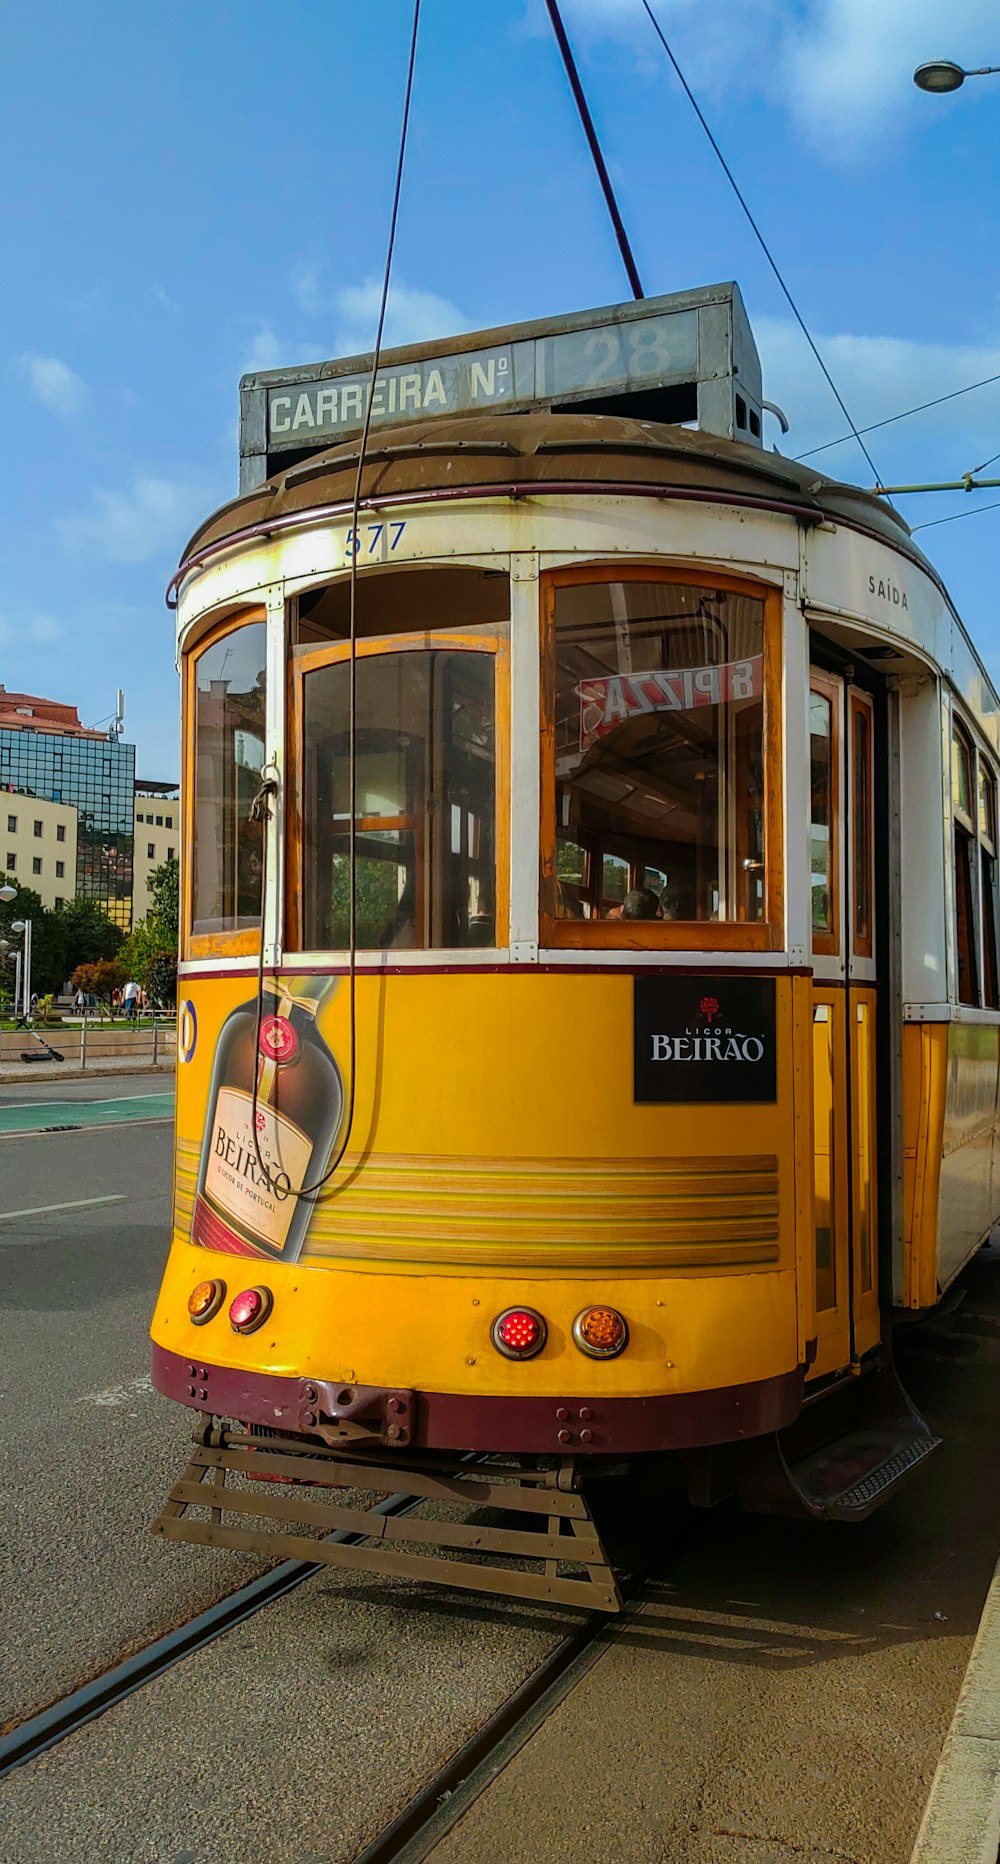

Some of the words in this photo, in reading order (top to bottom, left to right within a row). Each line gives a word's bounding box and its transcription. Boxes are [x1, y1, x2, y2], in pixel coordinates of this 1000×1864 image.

[270, 369, 447, 433] CARREIRA
[581, 322, 671, 387] 28
[345, 522, 407, 556] 577
[868, 575, 909, 611] SAÍDA
[650, 1033, 764, 1062] BEIRÃO
[685, 1027, 732, 1035] LICOR
[215, 1125, 291, 1201] BEIRÃO
[221, 1169, 236, 1185] LICOR
[236, 1181, 244, 1192] DE
[245, 1187, 276, 1213] PORTUGAL
